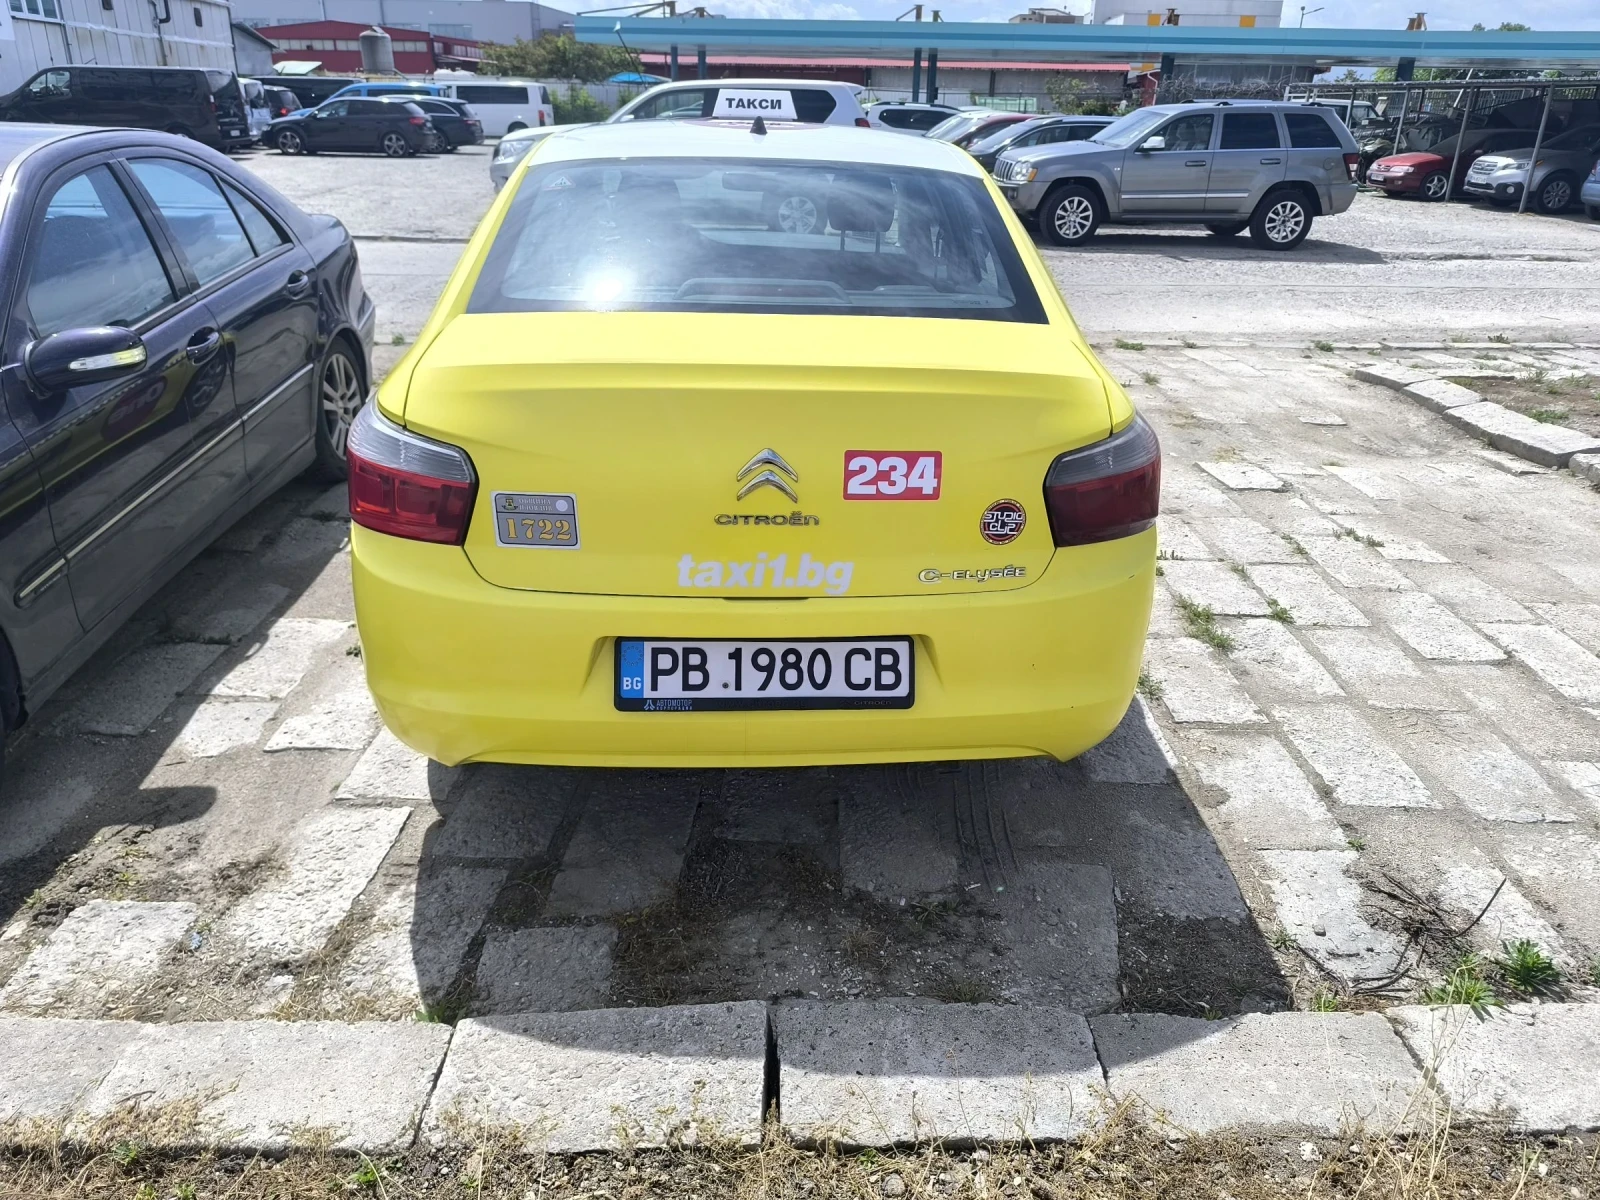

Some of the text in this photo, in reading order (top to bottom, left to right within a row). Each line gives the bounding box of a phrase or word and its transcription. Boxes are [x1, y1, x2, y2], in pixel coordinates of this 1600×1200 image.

[725, 97, 782, 110] ТАКСИ
[846, 456, 938, 495] 234
[506, 517, 572, 540] 1722
[984, 511, 1023, 523] STUDIO
[676, 552, 855, 596] taxi1.bg
[650, 647, 902, 691] PB 1980 CB
[623, 677, 642, 690] BG
